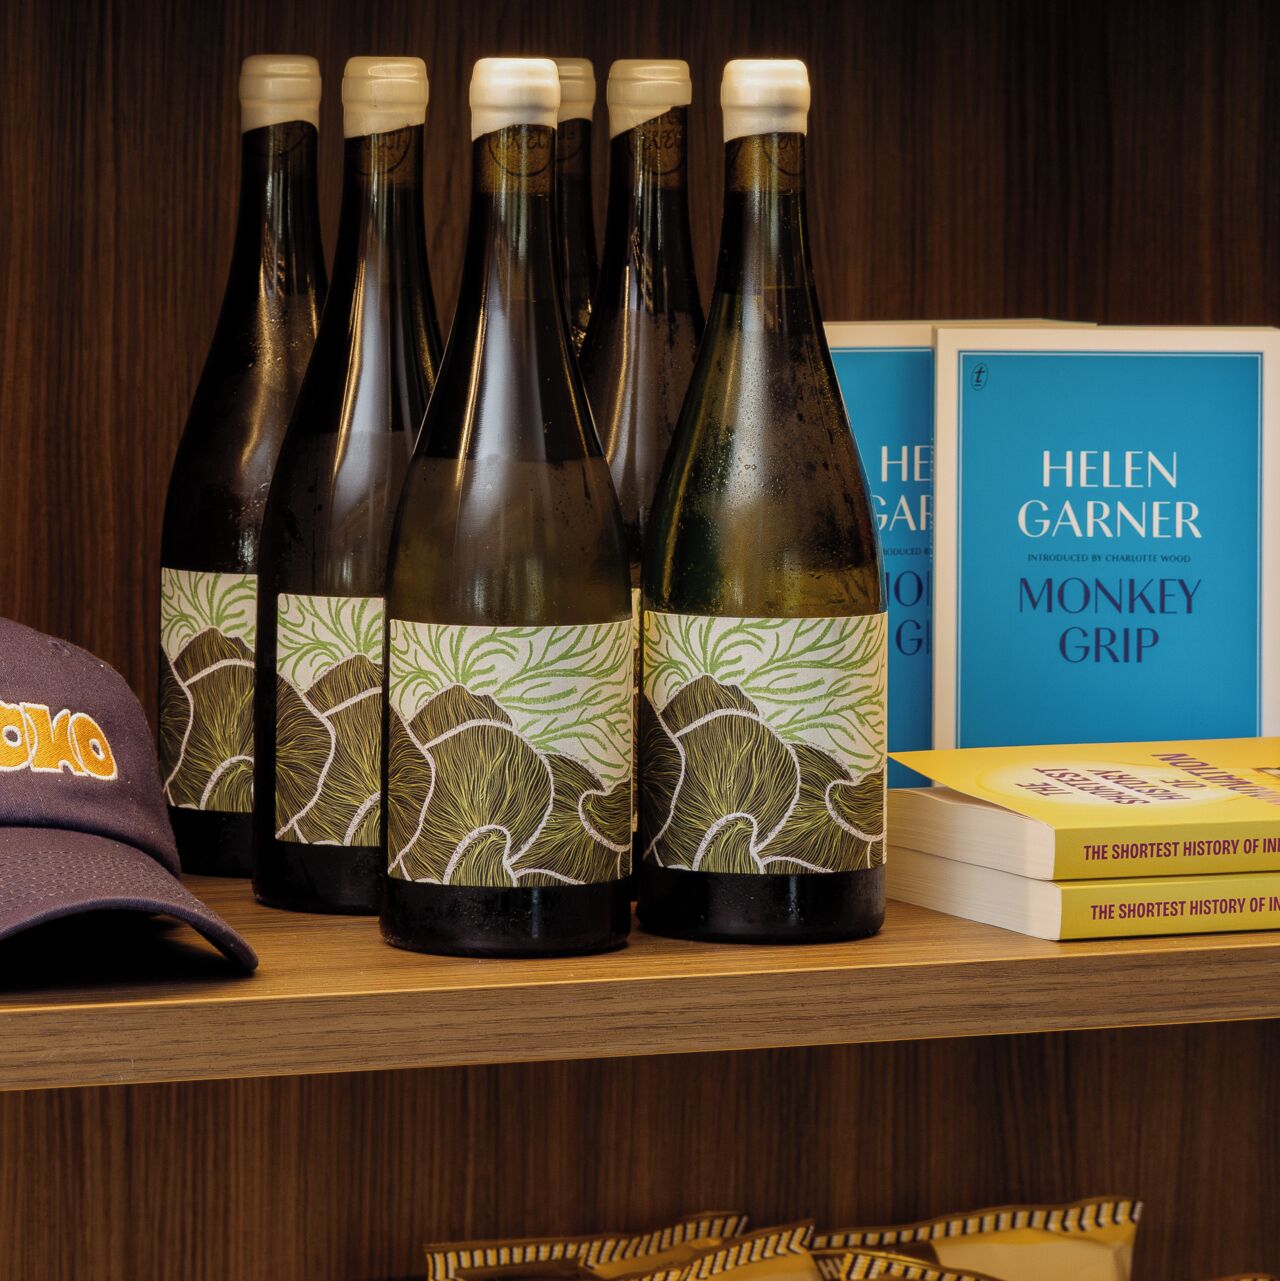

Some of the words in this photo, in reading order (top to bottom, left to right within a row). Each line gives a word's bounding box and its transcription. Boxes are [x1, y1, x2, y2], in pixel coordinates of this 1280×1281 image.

[1042, 450, 1177, 489] HELEN
[1017, 499, 1203, 539] GARNER
[1028, 553, 1088, 562] INTRODUCED
[1091, 553, 1102, 562] BY
[1105, 554, 1158, 563] CHARLOTTE
[1160, 554, 1191, 563] WOOD
[1019, 577, 1203, 615] MONKEY
[1059, 626, 1160, 664] GRIP
[1015, 782, 1073, 798] THE
[1032, 767, 1151, 805] SHORTEST
[1086, 769, 1192, 801] HISTORY
[1160, 778, 1207, 791] OF
[1083, 844, 1108, 861] THE
[1111, 841, 1180, 860] SHORTEST
[1183, 839, 1240, 857] HISTORY
[1243, 838, 1260, 854] OF
[1090, 903, 1116, 921] THE
[1118, 900, 1187, 920] SHORTEST
[1189, 897, 1246, 916] HISTORY
[1249, 896, 1266, 913] OF
